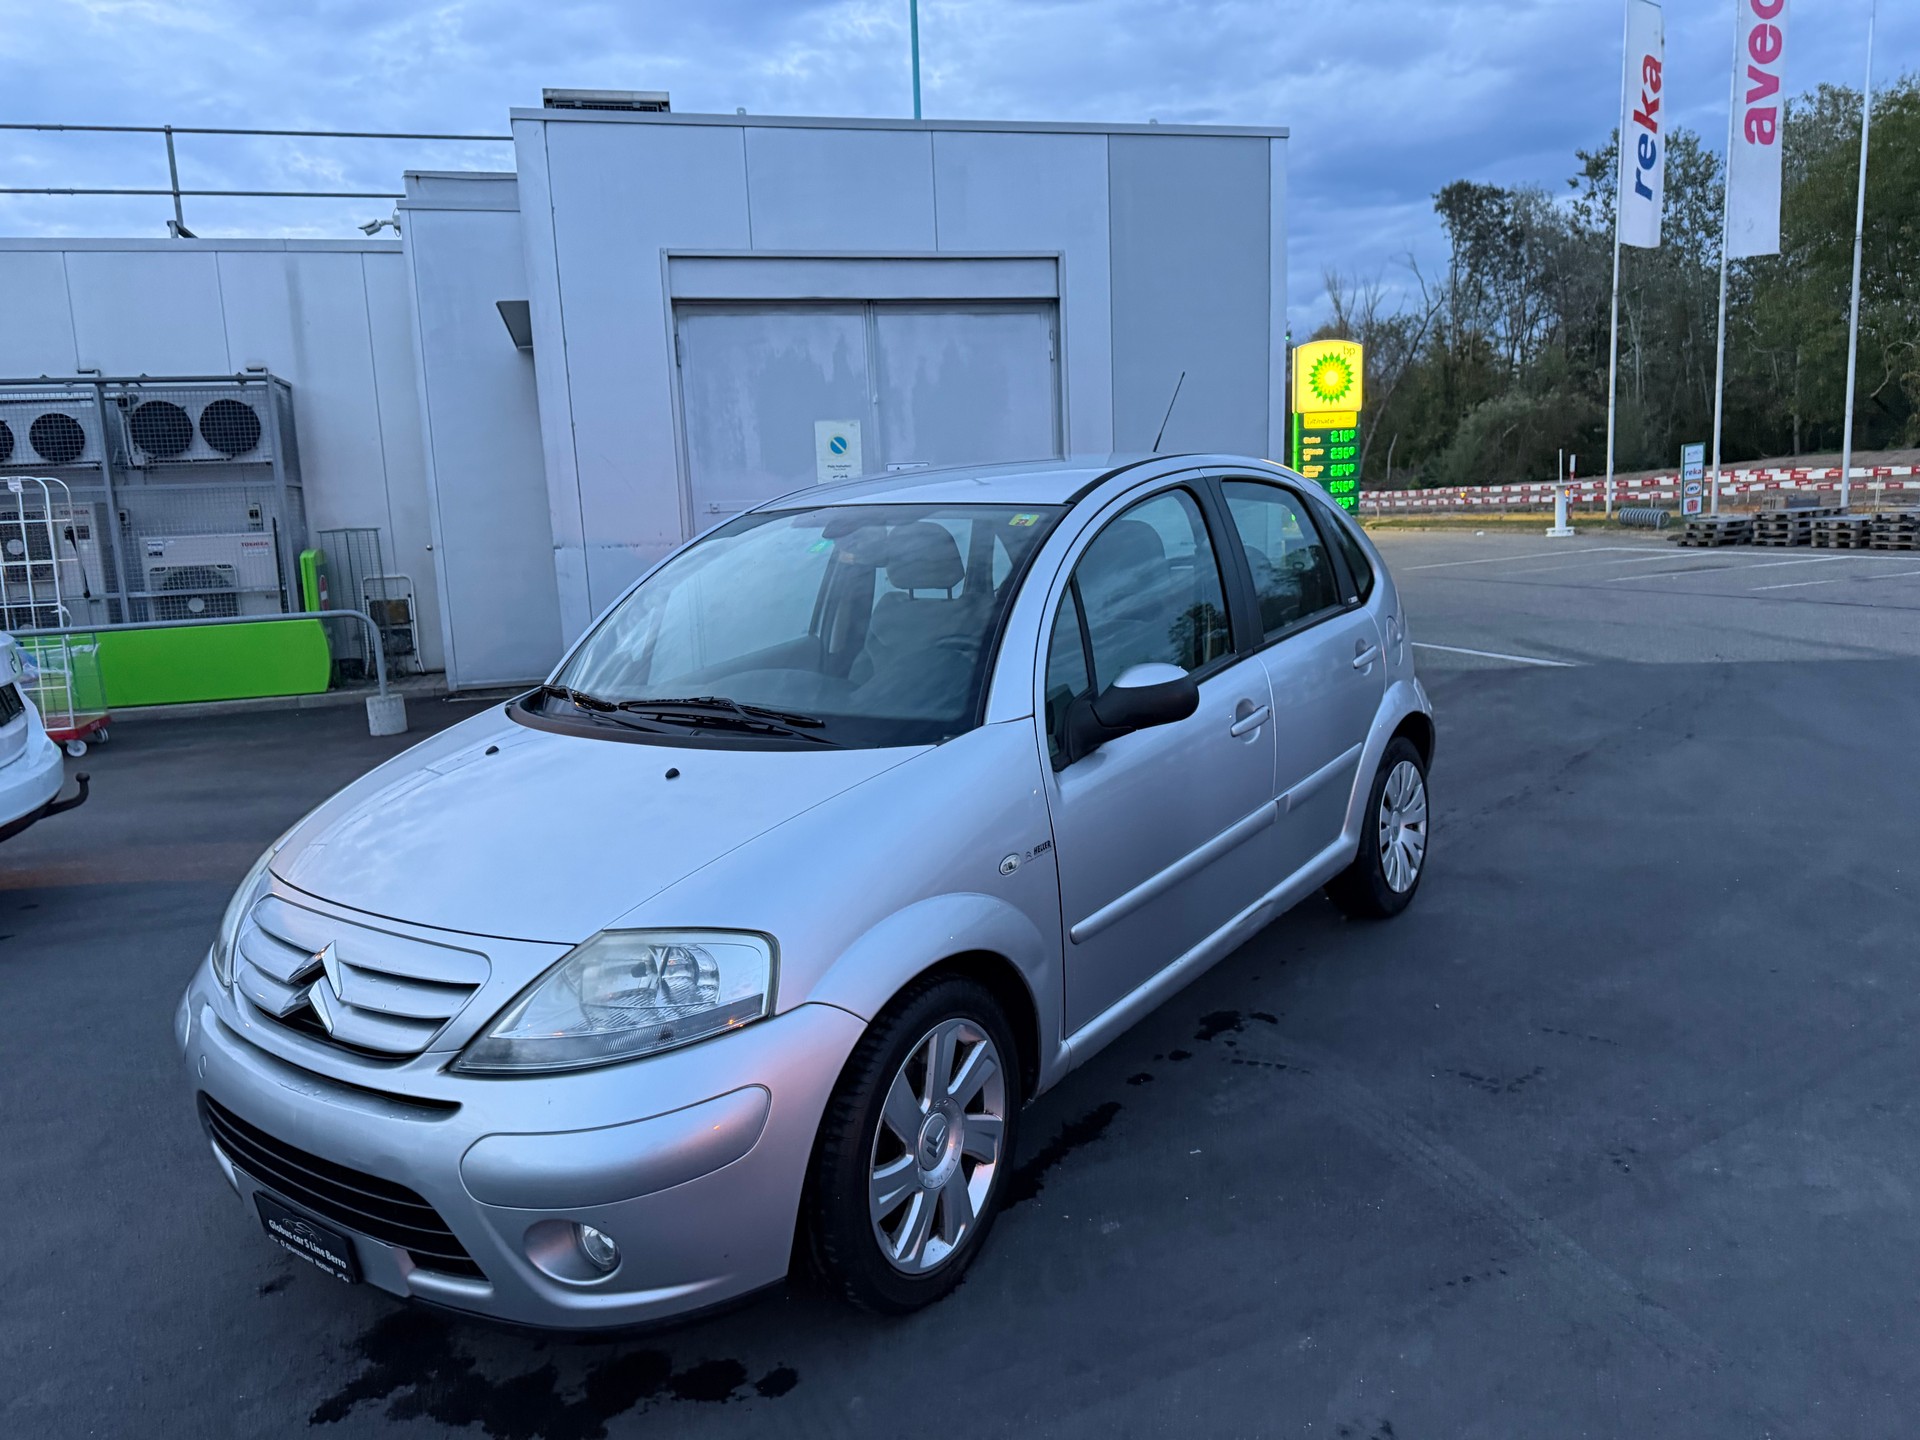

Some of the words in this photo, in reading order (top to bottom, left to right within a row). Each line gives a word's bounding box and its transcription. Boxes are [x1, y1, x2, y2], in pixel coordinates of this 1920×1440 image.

[1633, 54, 1662, 202] reka
[1343, 345, 1356, 357] bp
[1685, 467, 1702, 477] reka
